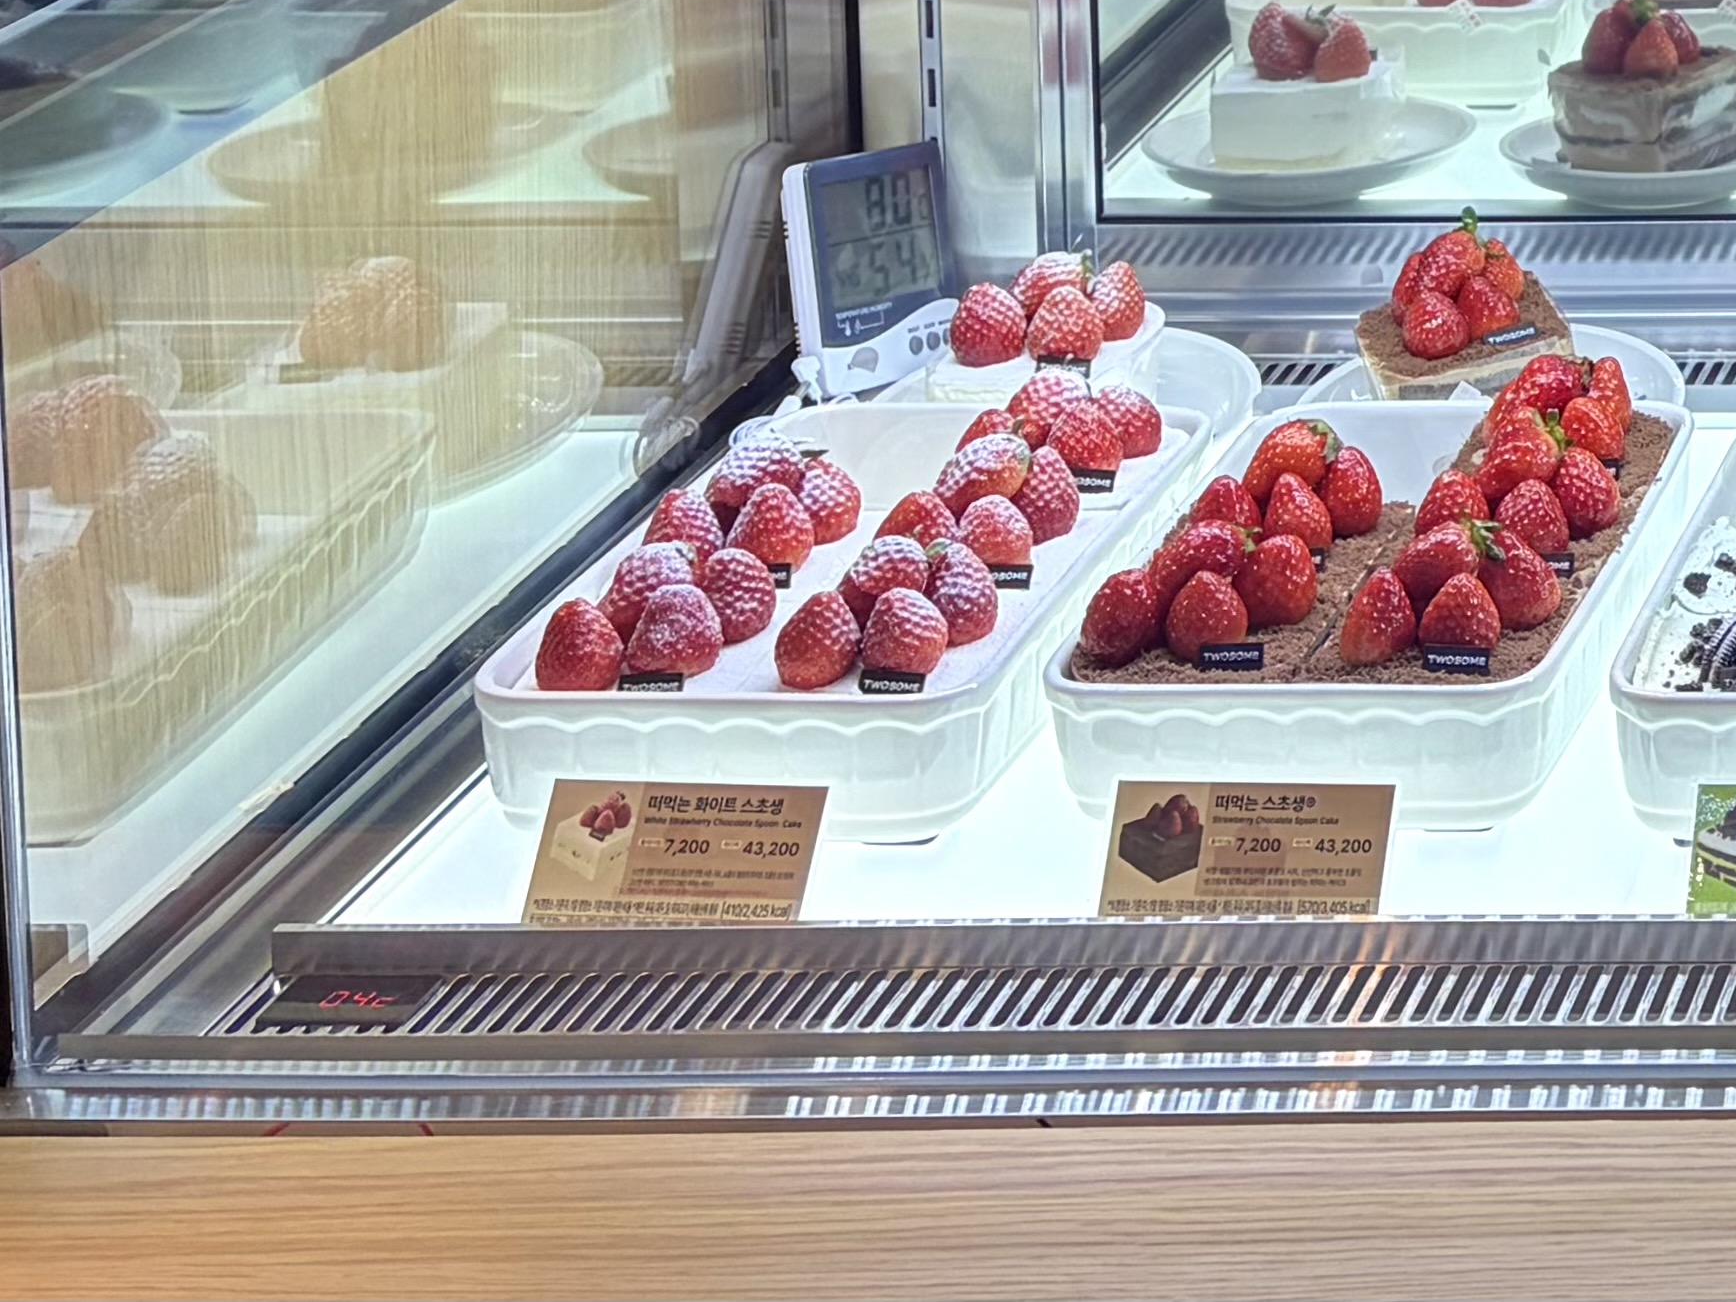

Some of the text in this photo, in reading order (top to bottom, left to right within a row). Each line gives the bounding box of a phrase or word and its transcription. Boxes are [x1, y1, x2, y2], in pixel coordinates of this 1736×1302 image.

[1203, 651, 1260, 662] TWOSOME
[648, 795, 785, 816] 떠먹는 화이트 스초생
[1214, 794, 1259, 811] 떠먹는
[663, 839, 800, 858] 7,200 43,200
[1235, 837, 1373, 855] 7,200 43,200
